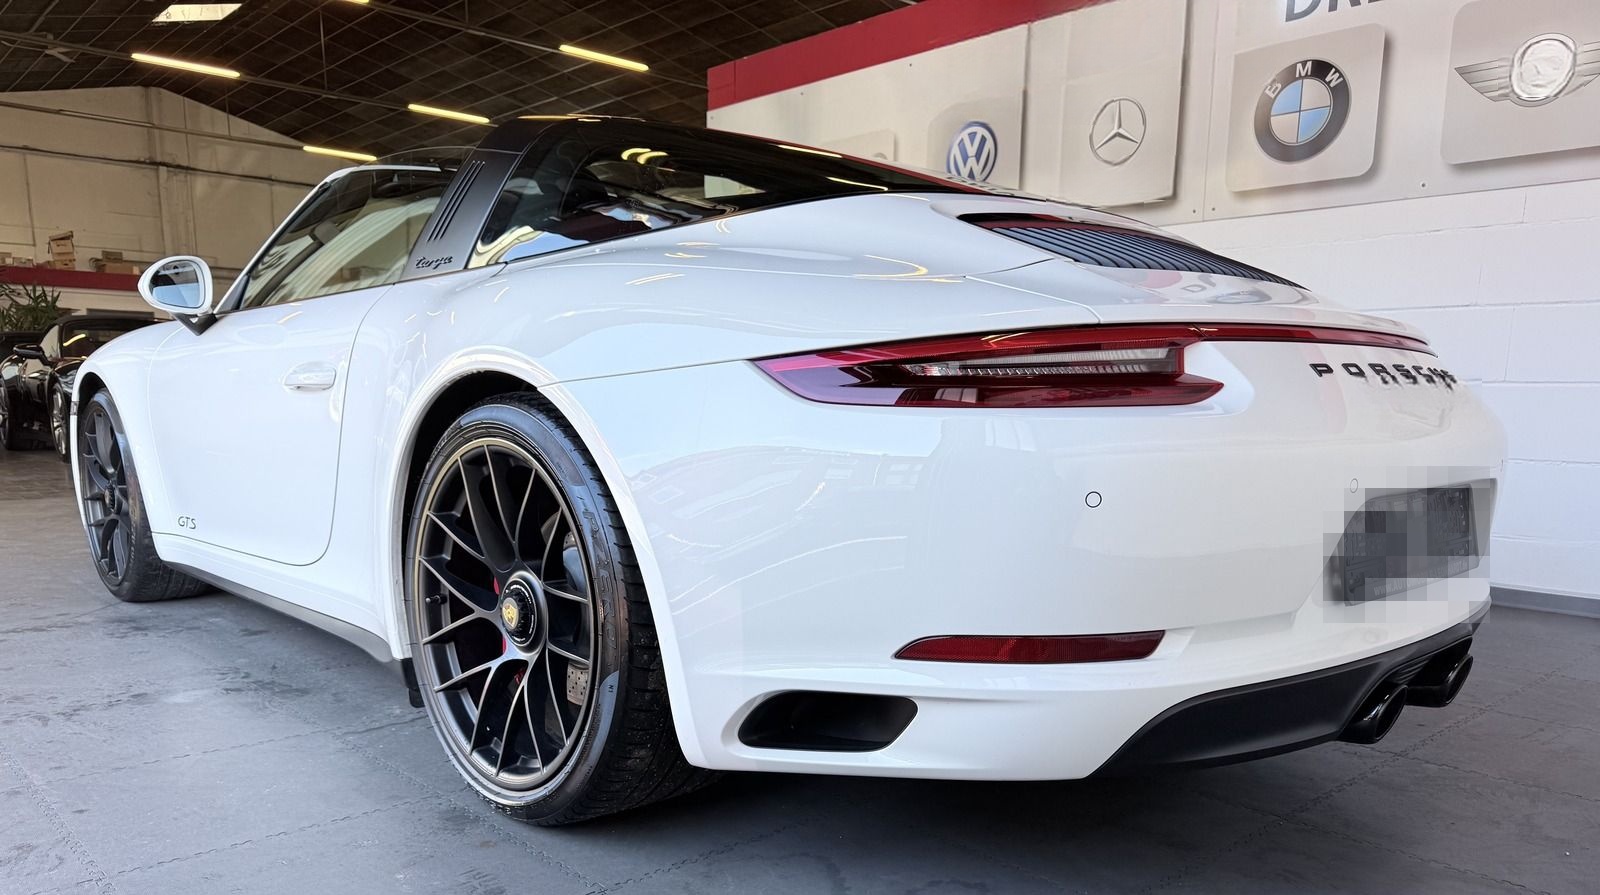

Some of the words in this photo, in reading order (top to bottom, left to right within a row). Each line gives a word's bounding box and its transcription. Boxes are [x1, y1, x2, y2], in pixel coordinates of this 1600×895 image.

[1265, 61, 1343, 99] BMW
[1309, 363, 1457, 389] PORSCHE
[178, 516, 196, 530] GTS
